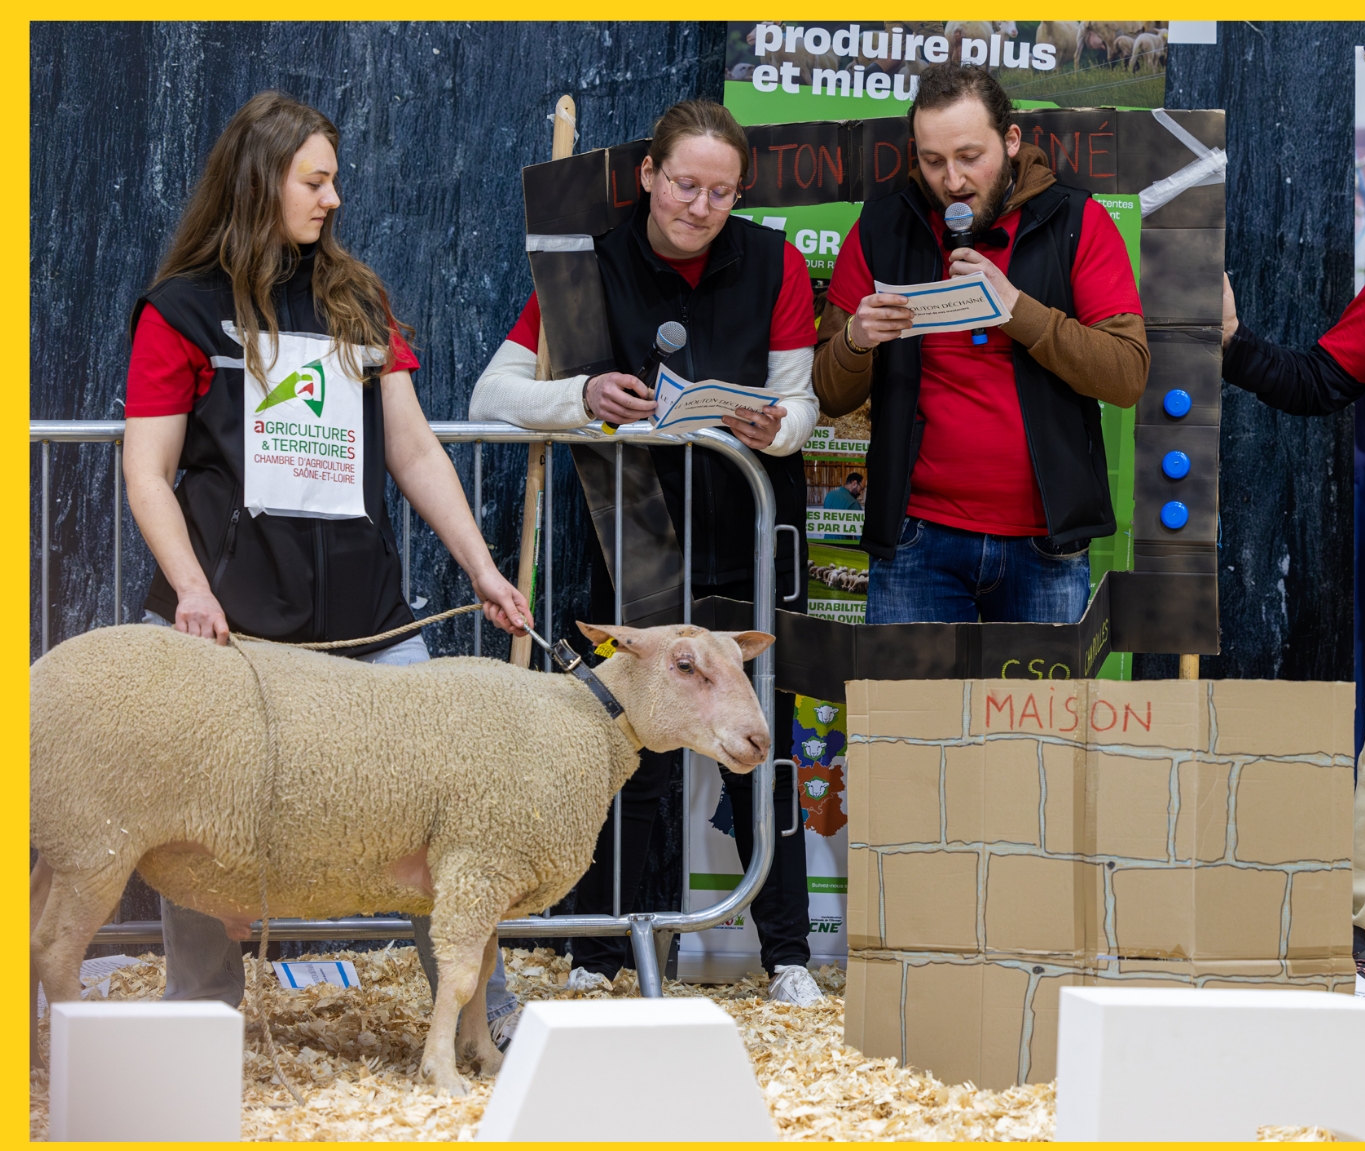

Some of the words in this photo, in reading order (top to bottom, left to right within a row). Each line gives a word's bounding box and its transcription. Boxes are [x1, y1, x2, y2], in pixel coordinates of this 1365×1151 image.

[755, 24, 949, 63] produire
[961, 33, 1057, 71] plus
[752, 61, 800, 94] et
[684, 398, 717, 406] MOUTON
[262, 441, 270, 450] &
[271, 438, 356, 459] TERRITOIRES
[804, 440, 826, 450] DES
[254, 454, 295, 466] CHAMBRE
[298, 457, 355, 473] D'AGRICULTURE
[293, 467, 355, 484] SAÔNE-ET-LOIRE
[817, 523, 840, 532] PAR
[843, 525, 857, 533] LA
